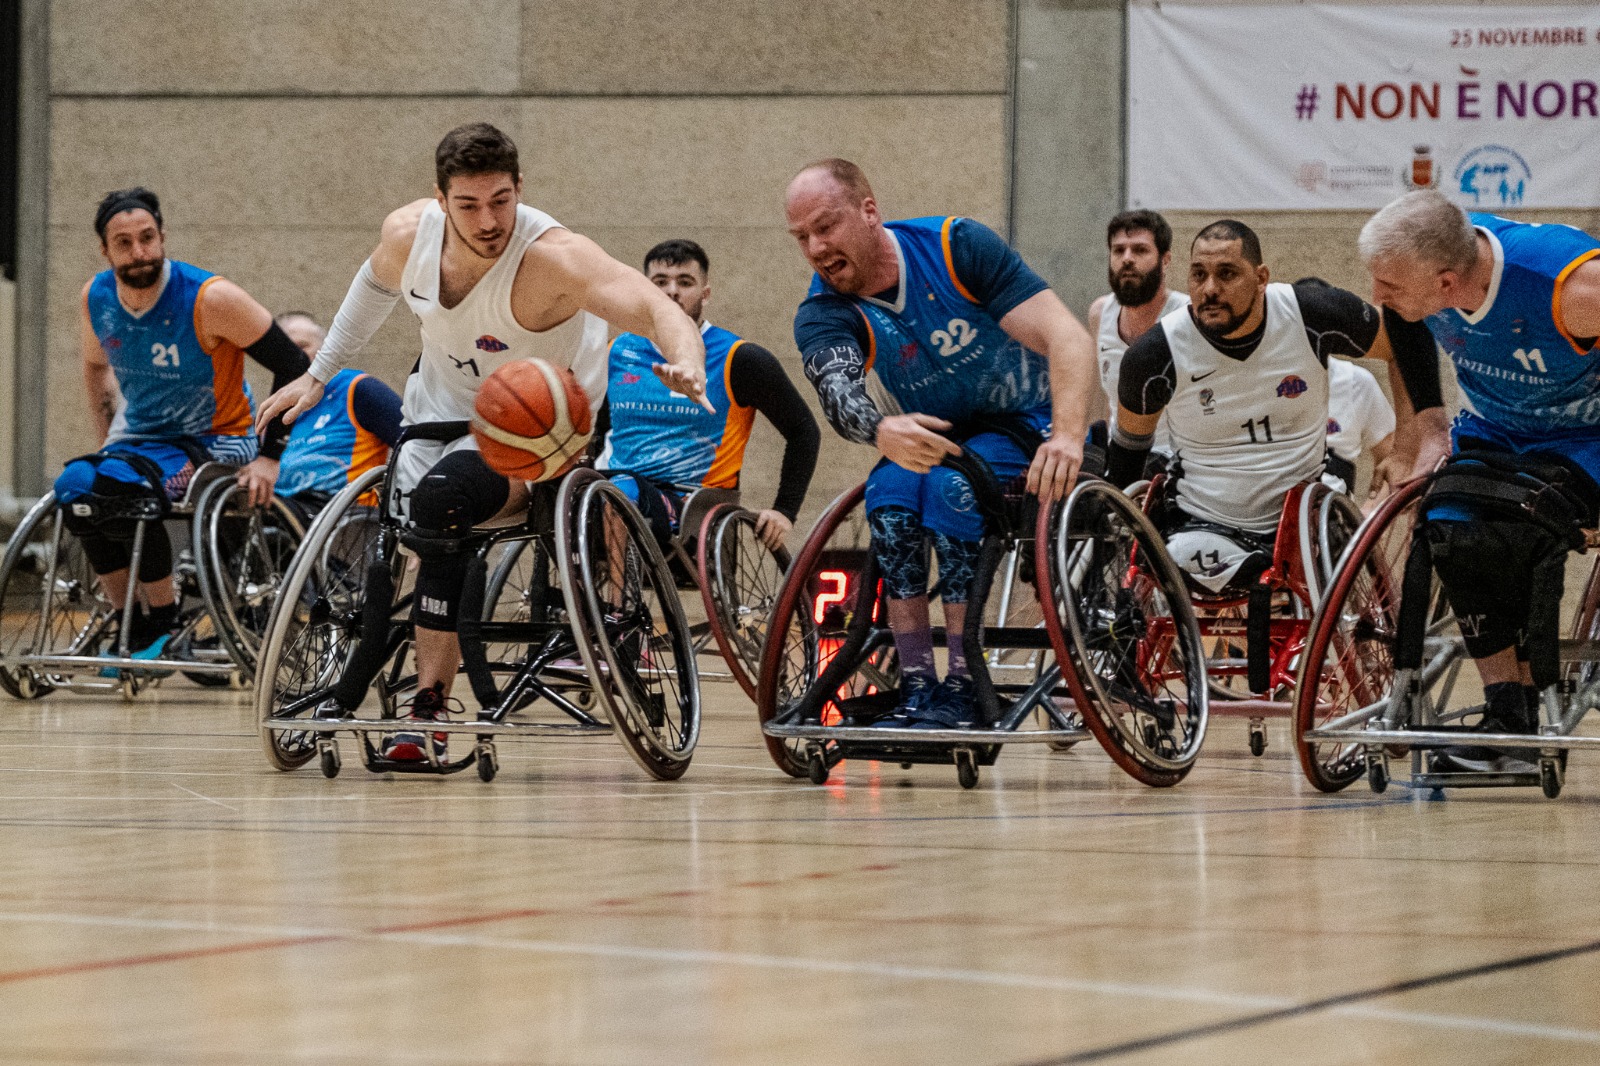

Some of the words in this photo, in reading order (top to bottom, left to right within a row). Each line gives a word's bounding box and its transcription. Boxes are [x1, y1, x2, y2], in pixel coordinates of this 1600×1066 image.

[1451, 28, 1473, 47] 25
[1478, 26, 1587, 46] NOVEMBRE
[1336, 82, 1441, 120] NON
[1457, 63, 1481, 119] È
[1496, 79, 1600, 119] NOR
[930, 317, 978, 357] 22
[150, 342, 180, 368] 21
[1512, 347, 1548, 373] 11
[1241, 414, 1273, 443] 11
[427, 597, 448, 616] NBA
